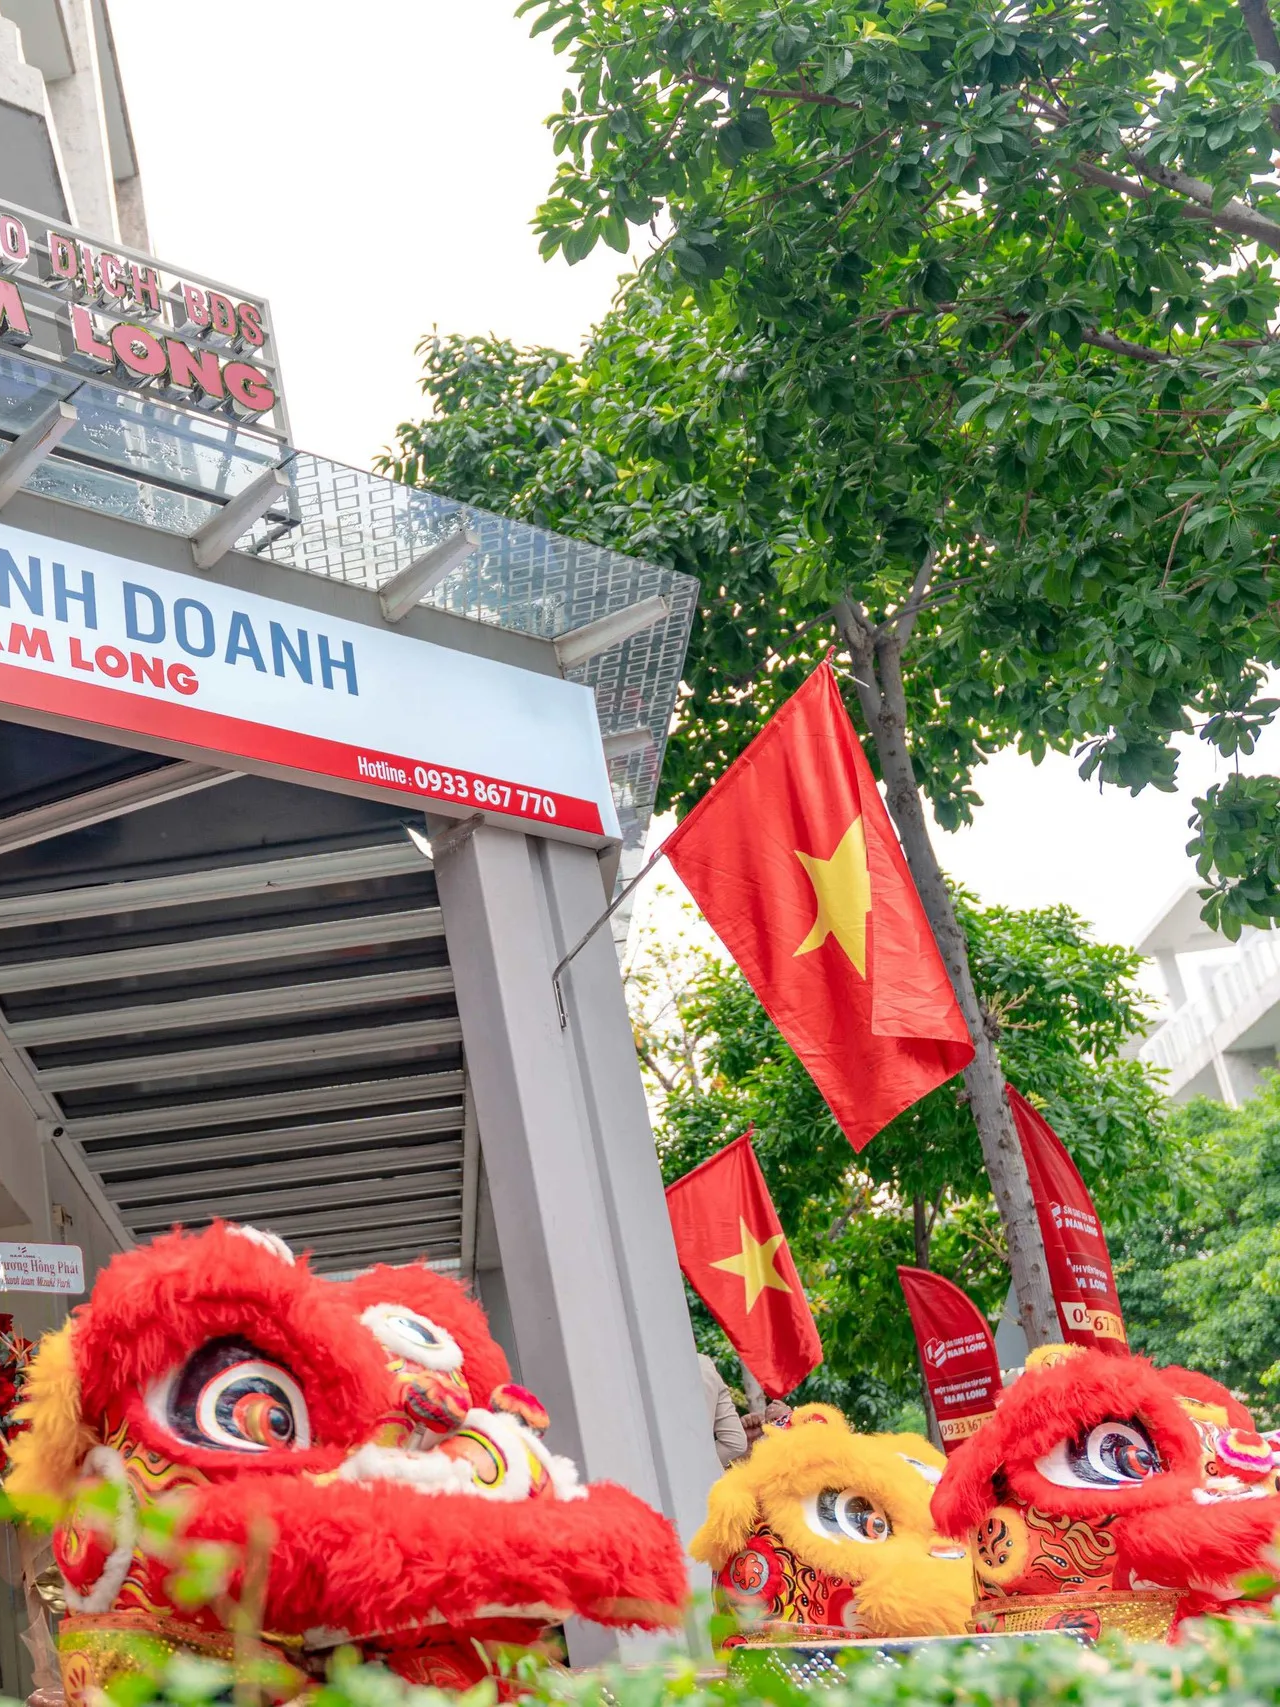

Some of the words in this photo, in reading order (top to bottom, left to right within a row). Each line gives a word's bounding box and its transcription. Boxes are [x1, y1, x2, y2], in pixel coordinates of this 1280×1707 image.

[46, 229, 161, 311] DỊCH
[182, 281, 267, 348] BĐS
[68, 301, 277, 412] LONG
[70, 637, 200, 696] LONG
[122, 580, 360, 697] DOANH
[414, 765, 470, 798] 0933
[473, 780, 512, 808] 867
[516, 789, 557, 818] 770
[57, 1260, 79, 1275] Phát
[942, 1422, 965, 1435] 0933
